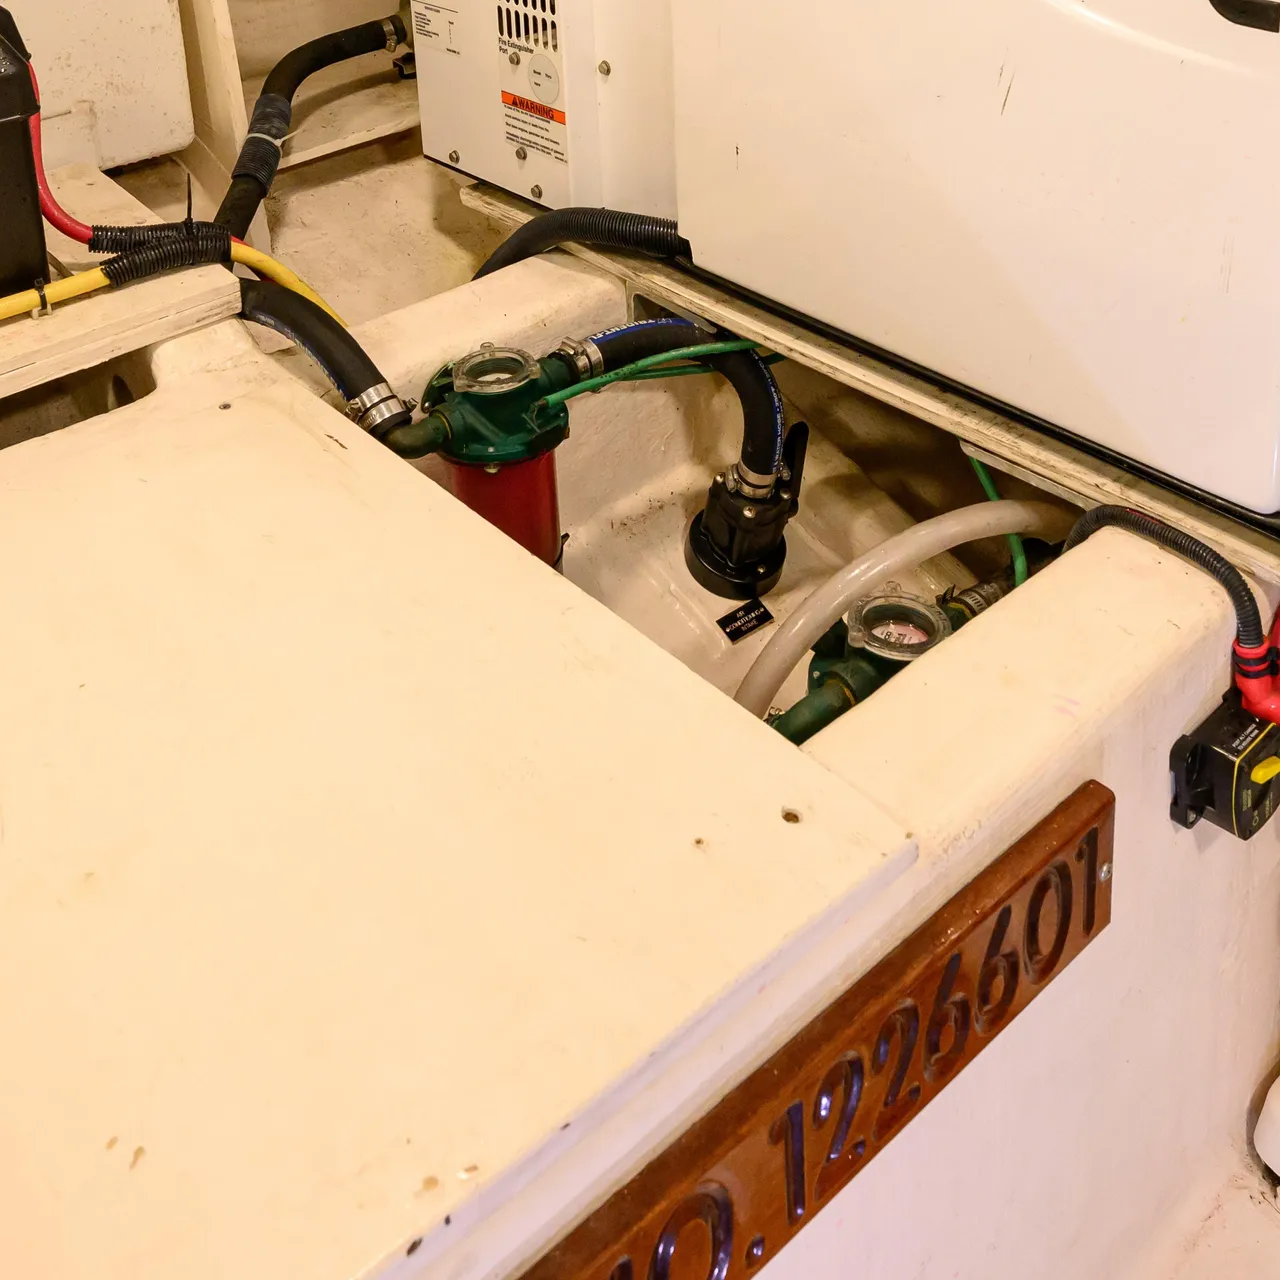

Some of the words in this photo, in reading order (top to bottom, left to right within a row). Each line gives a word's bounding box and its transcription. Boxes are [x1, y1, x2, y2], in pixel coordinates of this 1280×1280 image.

[507, 41, 534, 54] Extinguisher
[517, 98, 555, 120] WARNING
[768, 824, 1098, 1227] 1226601
